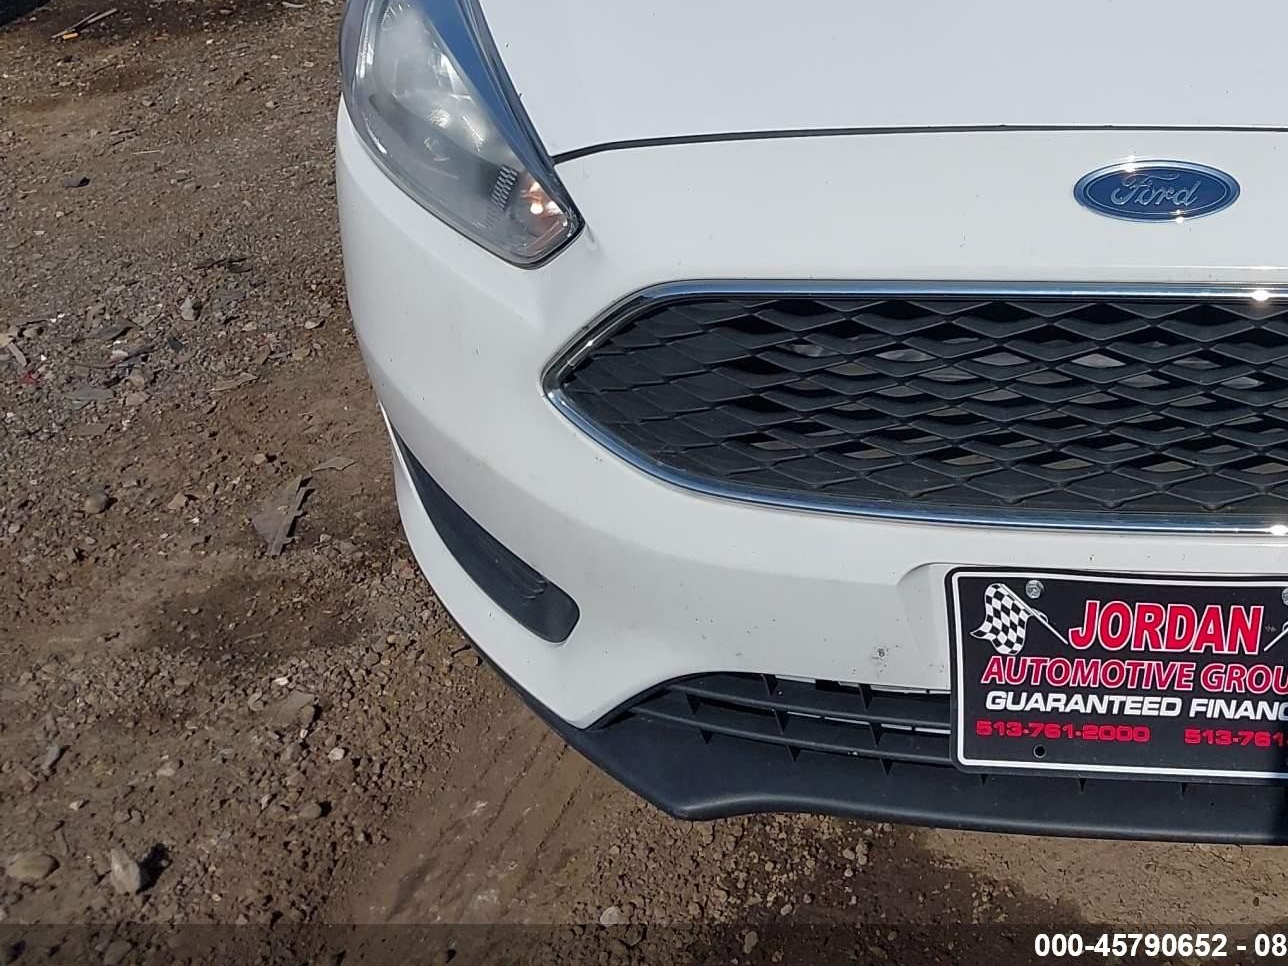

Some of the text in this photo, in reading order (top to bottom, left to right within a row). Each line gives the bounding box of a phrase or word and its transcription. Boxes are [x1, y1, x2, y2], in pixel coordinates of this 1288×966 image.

[1110, 173, 1201, 207] Ford
[1068, 600, 1264, 656] JORDAN
[981, 655, 1197, 691] AUTOMOTIVE
[985, 690, 1182, 717] GUARANTEED
[976, 720, 1151, 743] 513-761-2000
